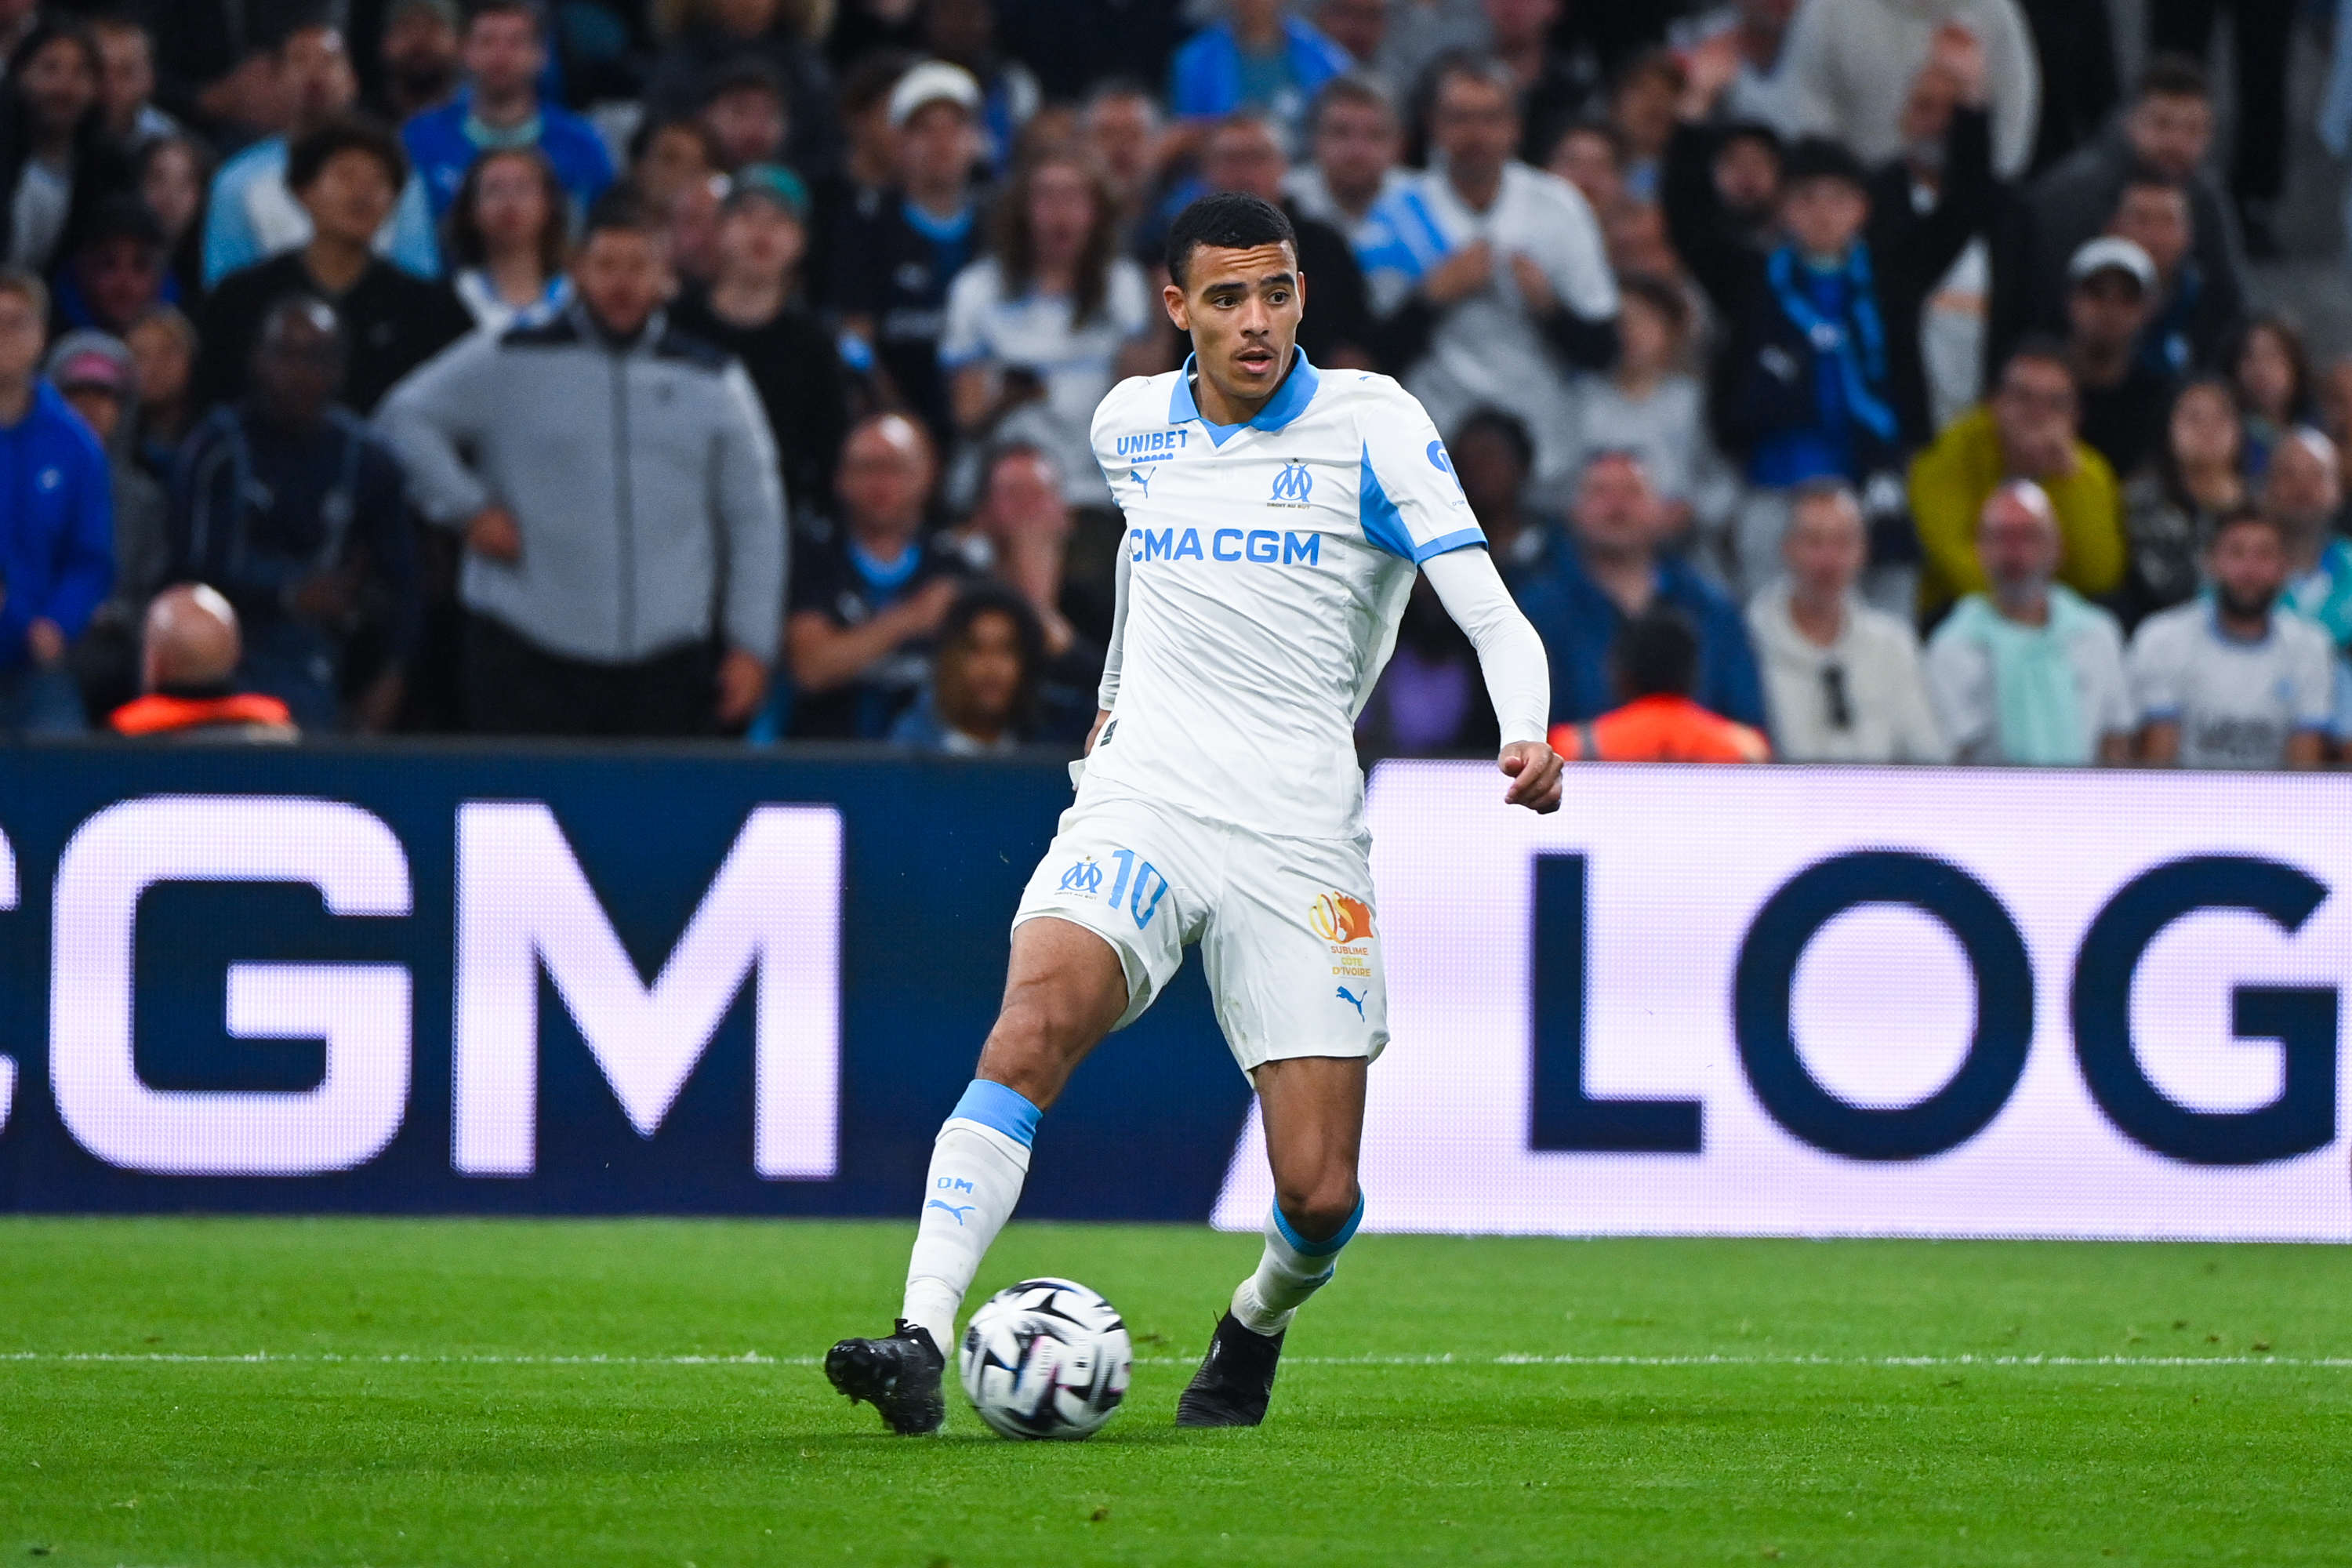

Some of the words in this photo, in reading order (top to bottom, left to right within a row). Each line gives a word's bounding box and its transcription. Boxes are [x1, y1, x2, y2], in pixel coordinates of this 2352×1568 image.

[1116, 429, 1189, 456] UNIBET
[1130, 528, 1204, 562] CMA
[1212, 528, 1320, 566] CGM
[1108, 849, 1168, 931] 10
[1330, 946, 1369, 956] SUBLIME
[0, 793, 844, 1179] GM
[1332, 966, 1371, 977] D'IVOIRE
[1529, 848, 2340, 1167] LOG
[937, 1178, 974, 1195] OM
